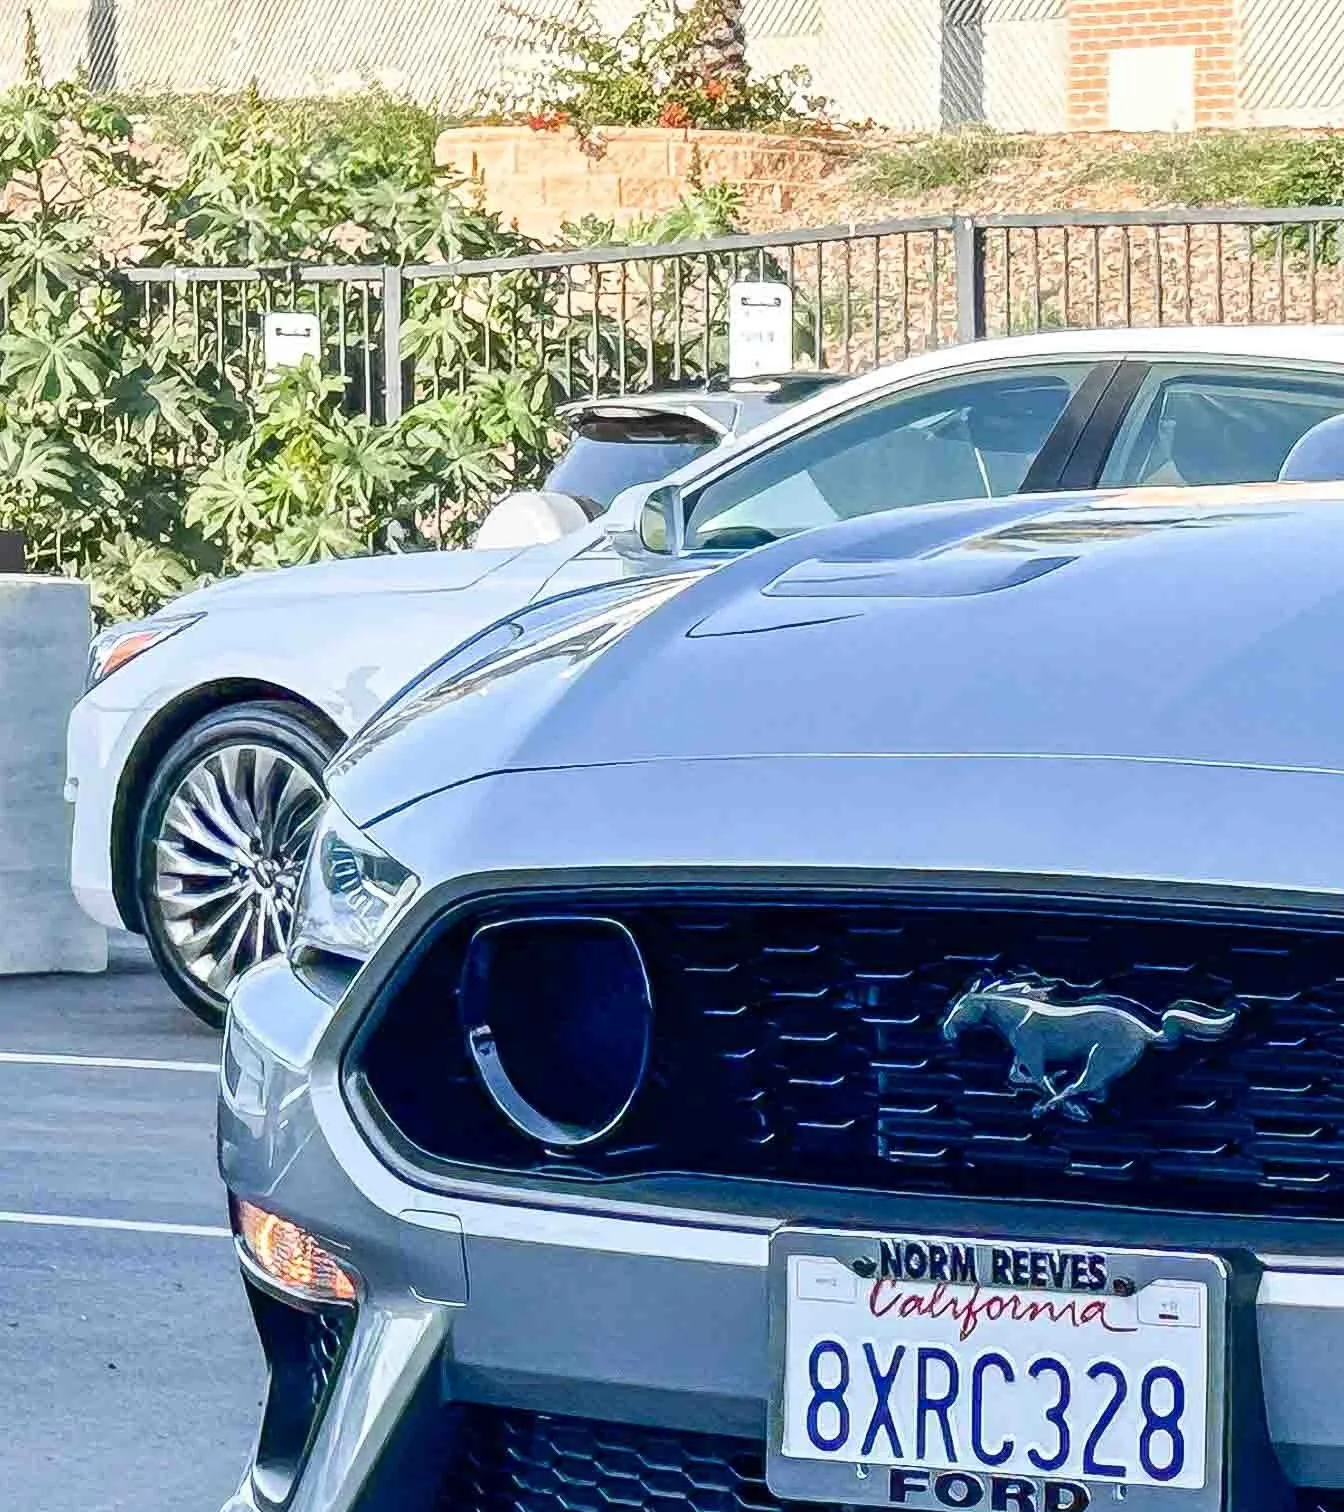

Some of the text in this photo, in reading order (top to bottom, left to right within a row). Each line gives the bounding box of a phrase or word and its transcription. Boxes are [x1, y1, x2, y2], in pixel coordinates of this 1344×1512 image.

[879, 1238, 1108, 1292] NORM REEVES
[868, 1277, 1138, 1342] California
[805, 1339, 1185, 1482] 8XRC328
